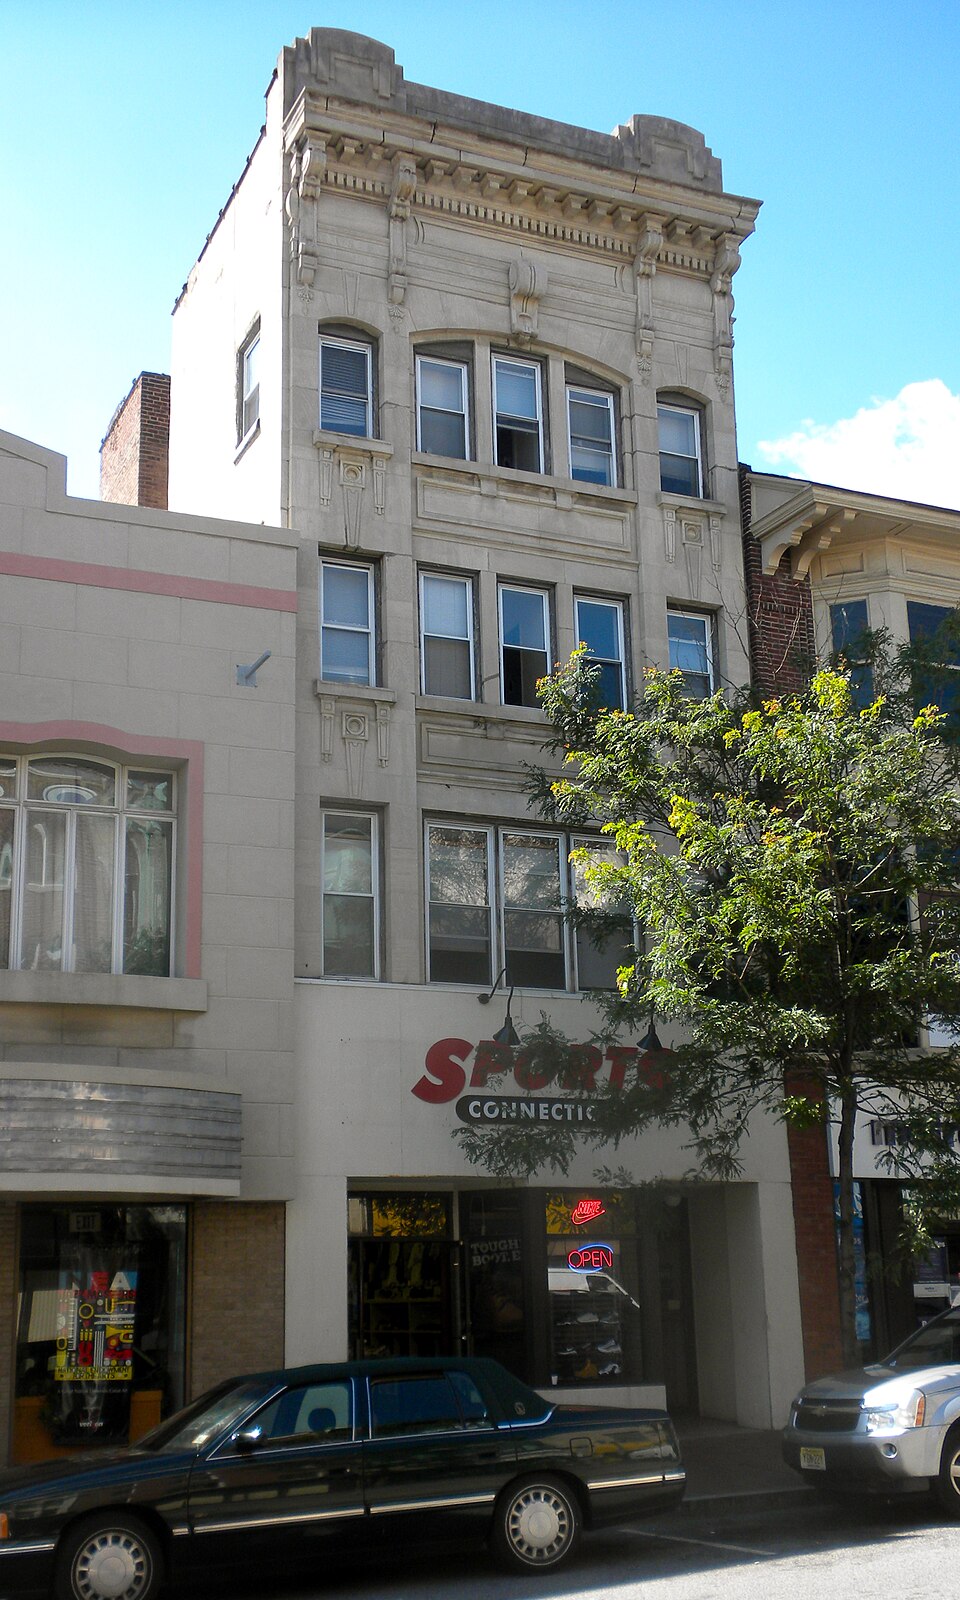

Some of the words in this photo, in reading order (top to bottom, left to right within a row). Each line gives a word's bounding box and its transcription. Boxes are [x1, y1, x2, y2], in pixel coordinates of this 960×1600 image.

[578, 1200, 602, 1215] NIKE
[470, 1239, 521, 1254] TOUGH
[568, 1250, 613, 1268] OPEN
